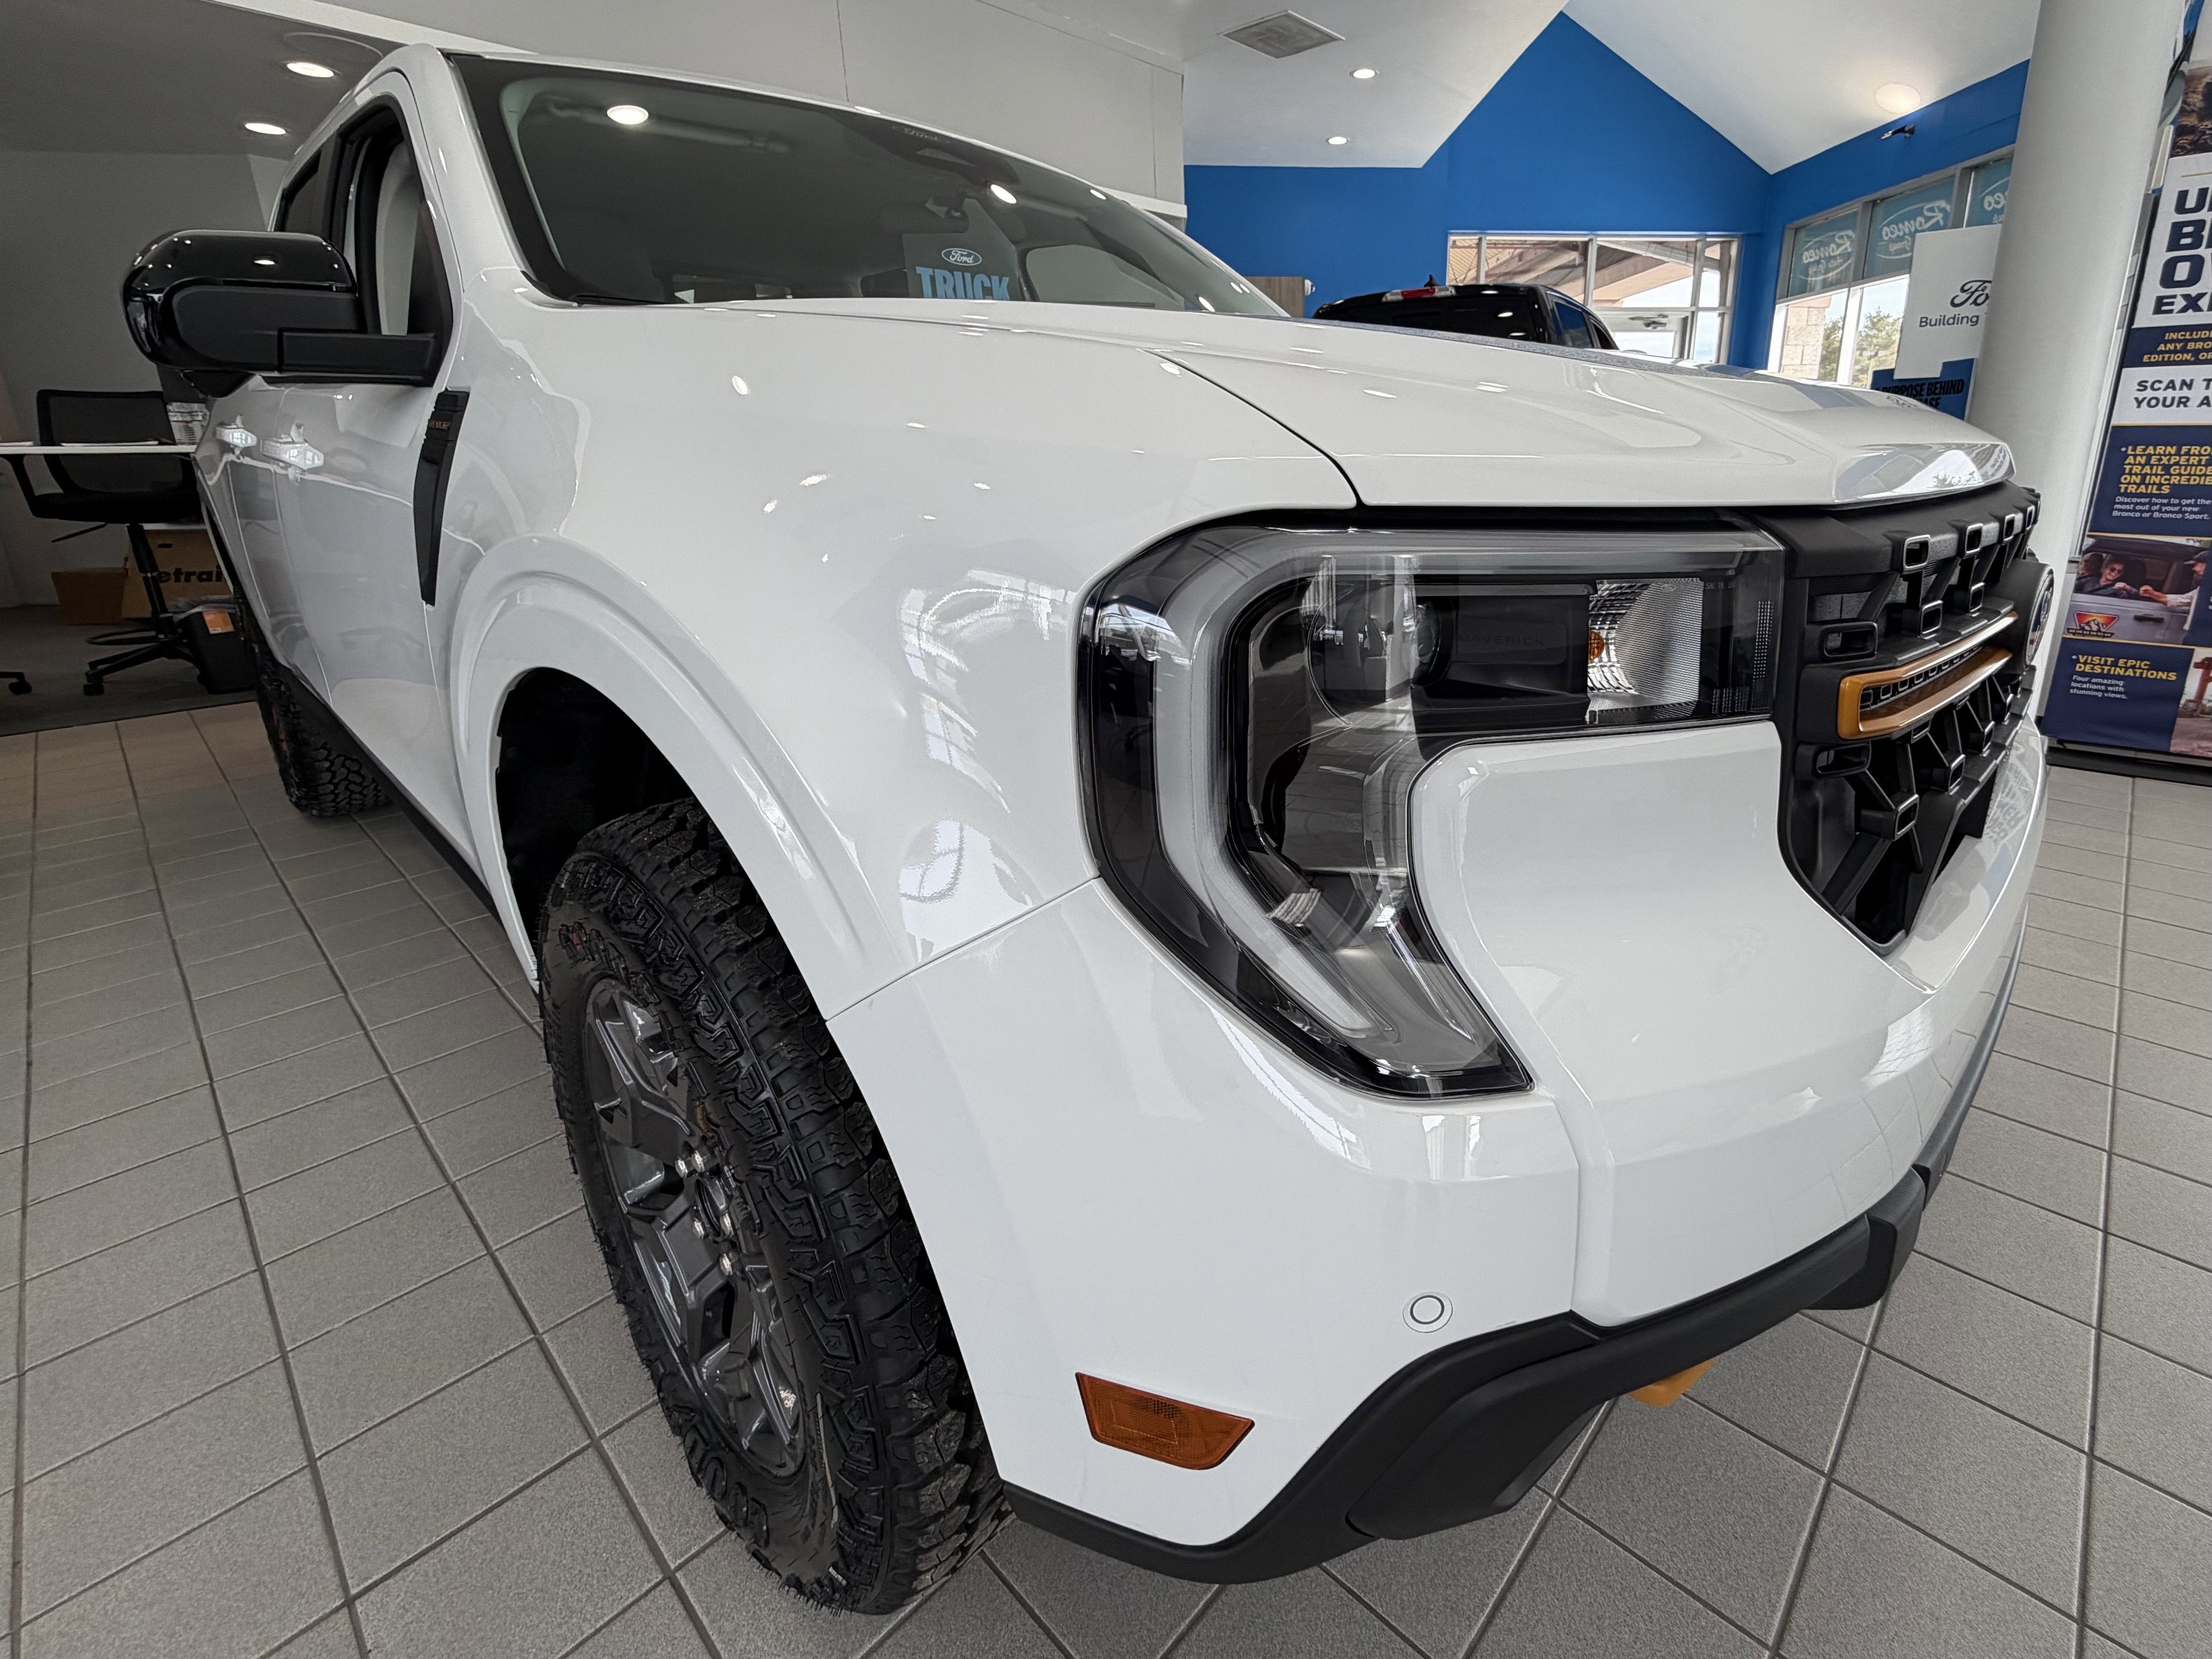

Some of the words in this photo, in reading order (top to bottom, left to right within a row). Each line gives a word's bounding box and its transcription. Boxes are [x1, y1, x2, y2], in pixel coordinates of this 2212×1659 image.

[916, 266, 1010, 300] TRUCK
[1950, 279, 1992, 308] Fo
[1919, 313, 1979, 327] Building
[2157, 342, 2184, 351] ANY
[2187, 341, 2212, 350] BRO
[2143, 353, 2194, 362] EDITION,
[1926, 378, 1964, 396] BEHIND
[2136, 379, 2194, 392] SCAN
[2133, 396, 2190, 409] YOUR
[2127, 446, 2177, 454] LEARN
[2180, 446, 2212, 455] FRO
[2124, 455, 2147, 464] AN
[2150, 455, 2210, 465] EXPERT
[2123, 465, 2165, 474] TRAIL
[2120, 474, 2141, 484] ON
[2145, 475, 2212, 484] INCREDIB
[2119, 484, 2171, 494] TRAILS
[2078, 654, 2114, 665] VISIT
[2118, 658, 2151, 669] EPIC
[2075, 663, 2177, 681] DESTINATIONS
[2070, 681, 2106, 690] locations
[2091, 677, 2124, 686] amazing
[2069, 688, 2102, 698] stunning
